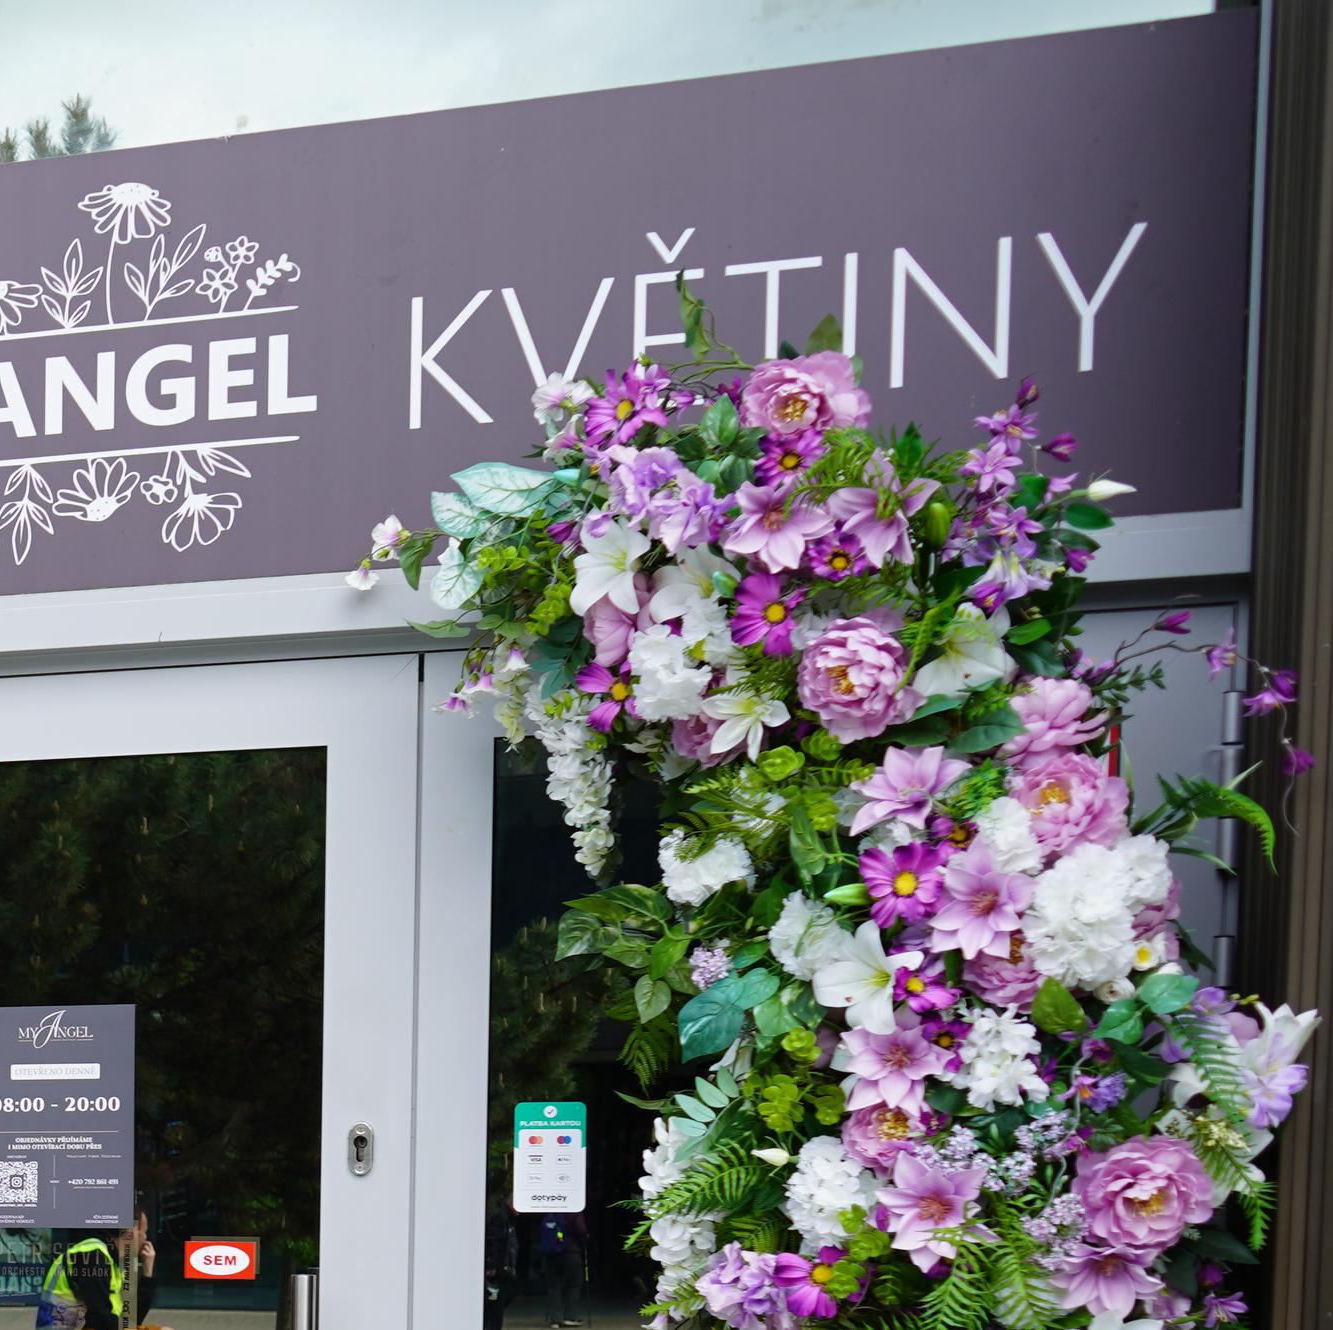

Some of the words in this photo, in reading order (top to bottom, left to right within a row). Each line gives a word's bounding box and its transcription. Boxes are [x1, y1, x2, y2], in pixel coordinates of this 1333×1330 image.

[18, 1026, 40, 1039] MY
[33, 1009, 94, 1049] ANGEL
[14, 1065, 63, 1076] OTEVŘENO
[64, 1065, 96, 1075] DENNĚ
[64, 1096, 121, 1112] 20:00
[531, 1194, 568, 1203] dotypay
[203, 1255, 237, 1266] SEM
